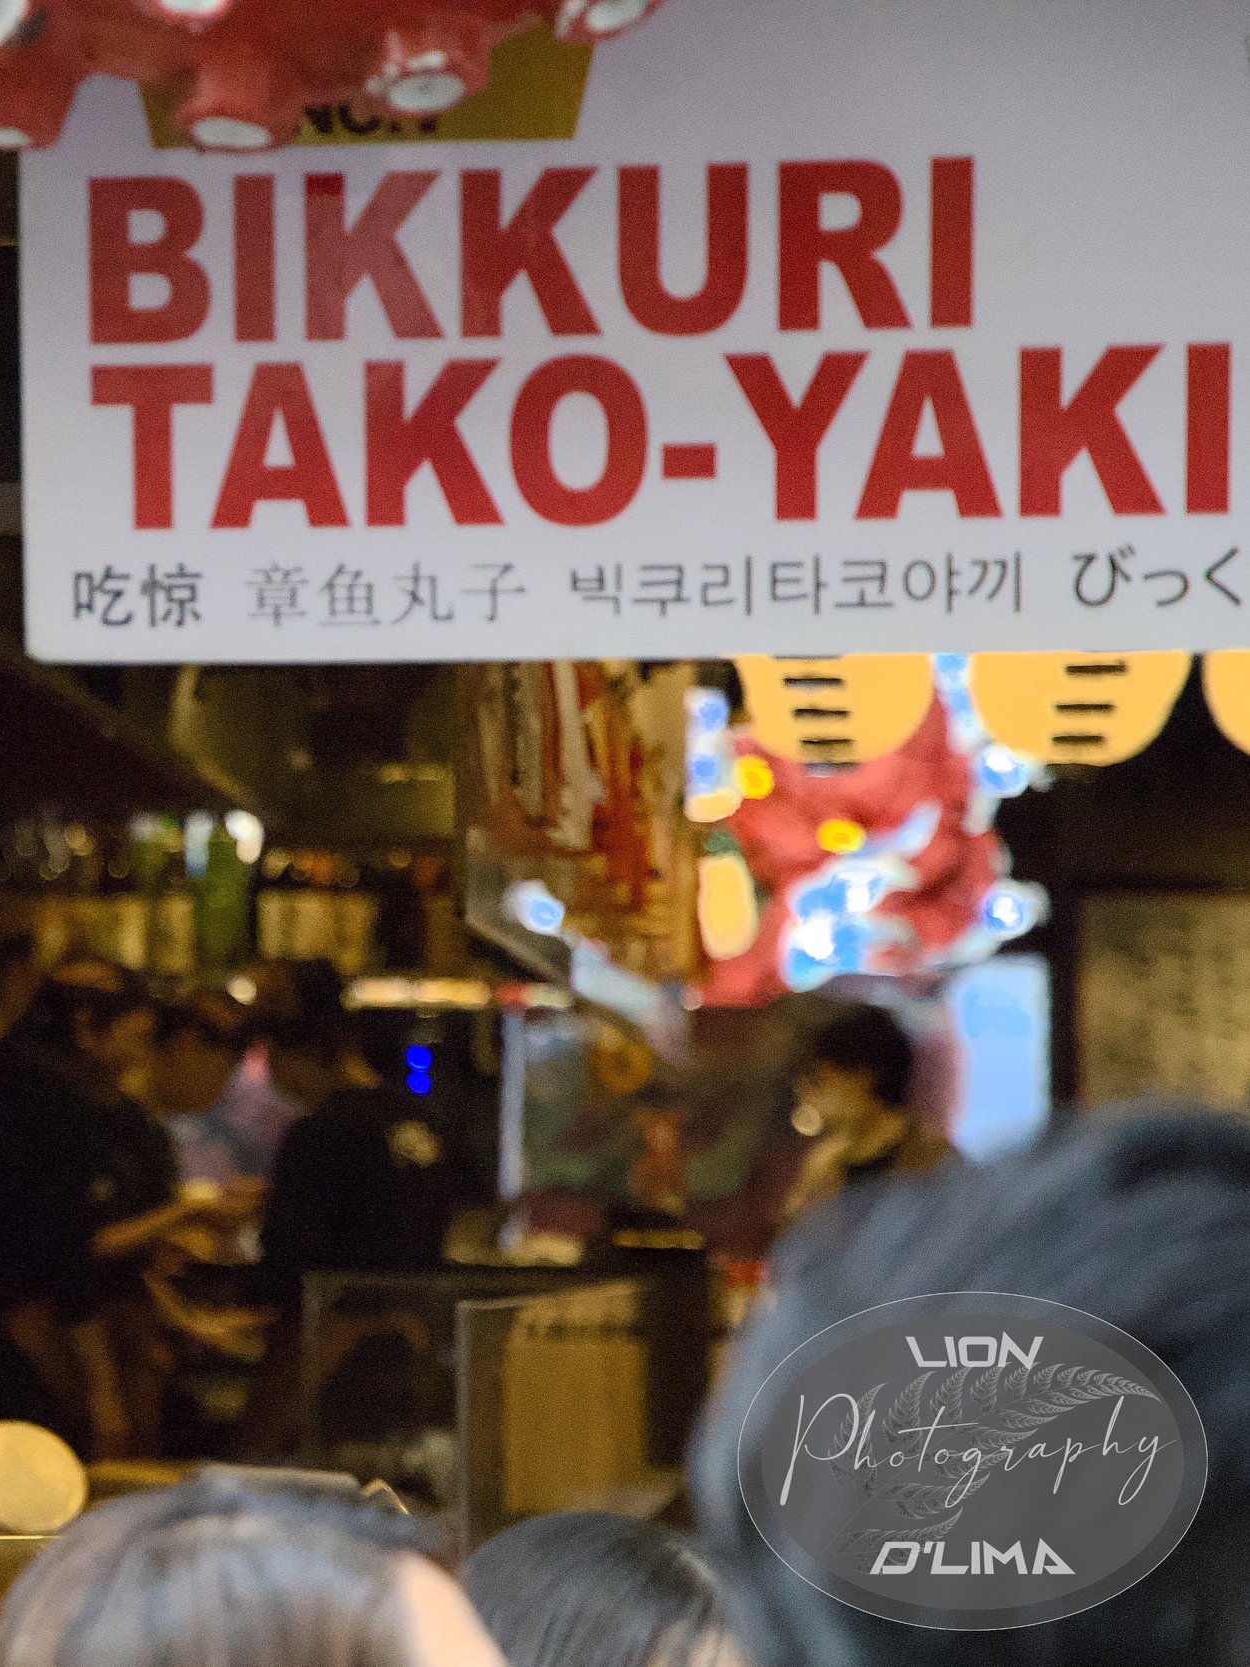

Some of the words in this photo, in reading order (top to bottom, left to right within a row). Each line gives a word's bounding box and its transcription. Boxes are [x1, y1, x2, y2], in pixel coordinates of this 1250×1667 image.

[88, 155, 976, 346] BIKKURI
[89, 342, 1233, 531] TAKO-YAKI
[72, 562, 204, 628] 吃惊
[244, 560, 527, 629] 章鱼丸子
[568, 550, 1023, 617] 빅쿠리타코야끼
